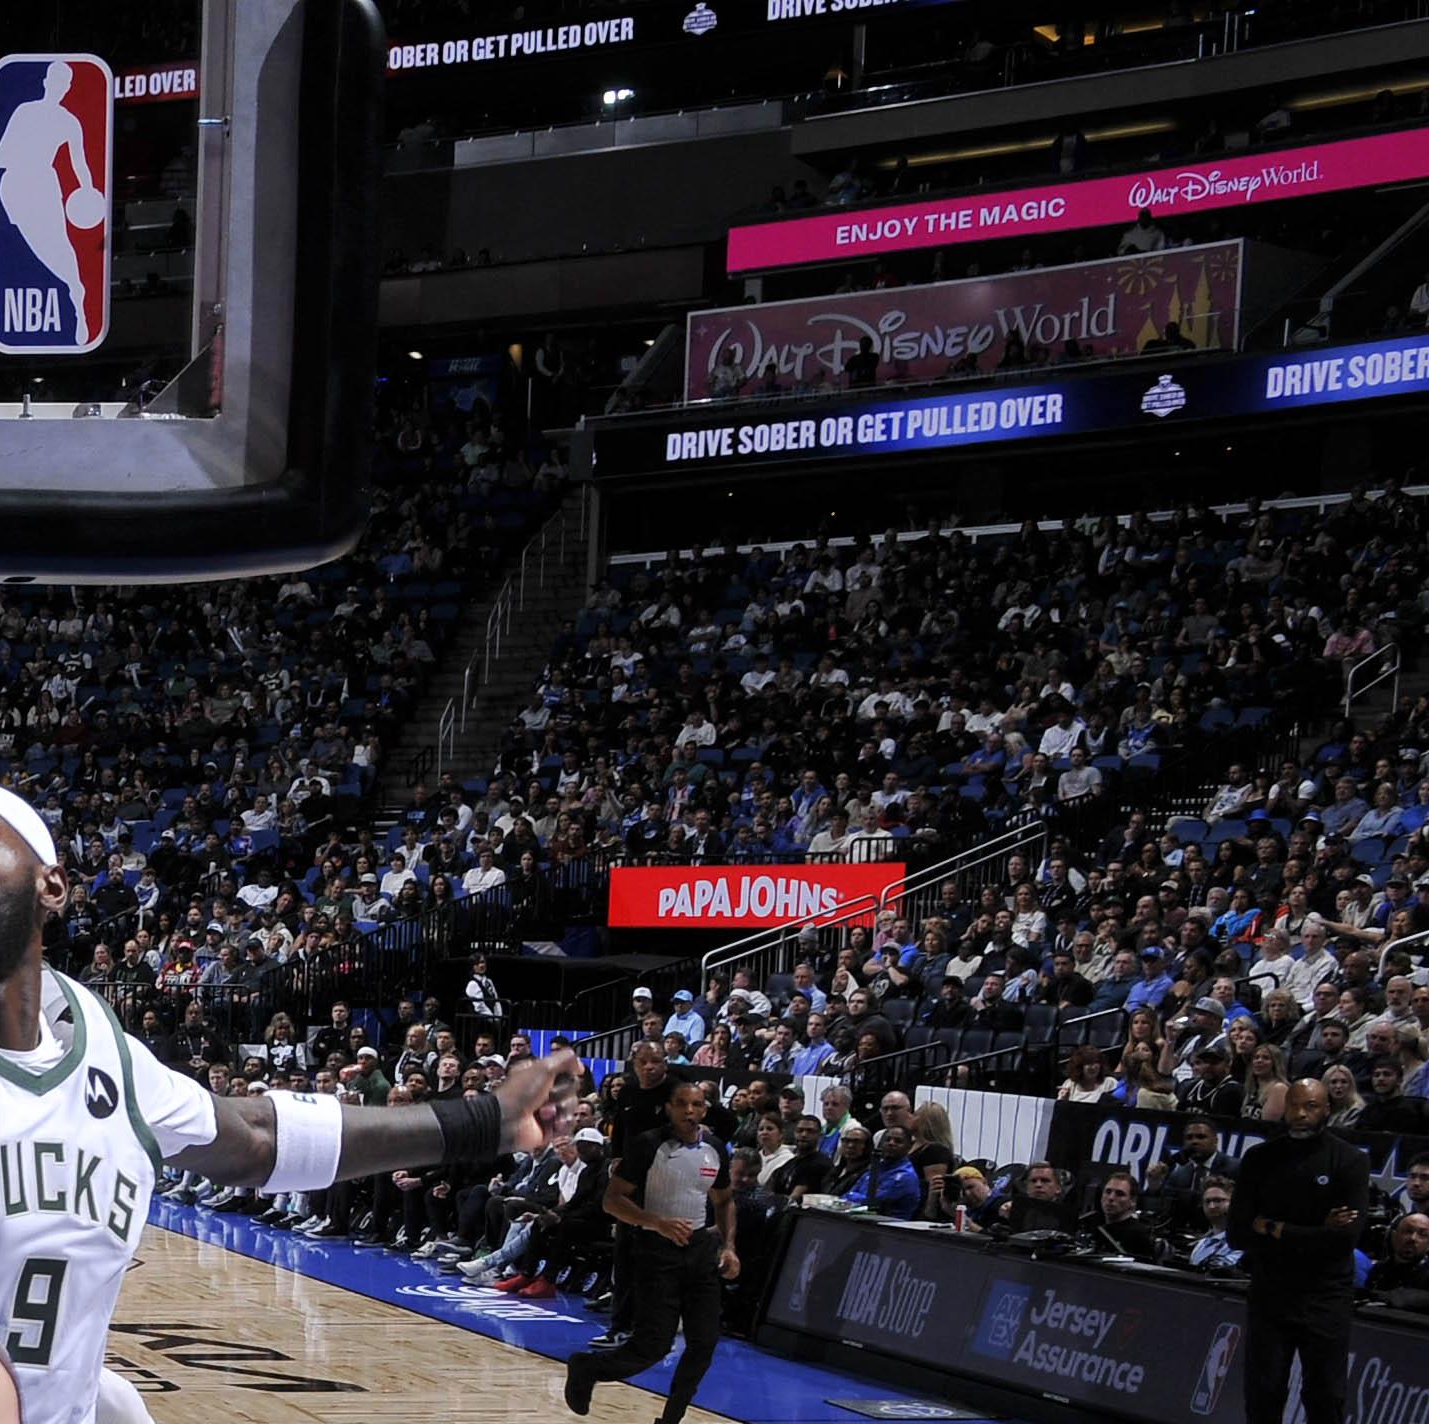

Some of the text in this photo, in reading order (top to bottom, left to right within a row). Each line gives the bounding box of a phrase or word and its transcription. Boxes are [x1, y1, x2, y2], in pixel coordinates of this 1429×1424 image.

[388, 17, 634, 69] OBER OR GET PULLED OVER
[150, 68, 196, 97] OVER
[1261, 161, 1320, 187] World
[835, 198, 1066, 246] ENJOY THE MAGIC
[4, 287, 61, 334] NBA
[995, 294, 1117, 346] World
[1266, 357, 1343, 400] DRIVE
[665, 392, 1063, 462] DRIVE SOBER OR GET PULLED OVER
[657, 876, 839, 919] PAPA JOHNS
[7, 1256, 69, 1367] 9
[836, 1250, 938, 1339] NBA Store
[1030, 1288, 1118, 1350] Jersey
[1013, 1330, 1144, 1394] Assurance
